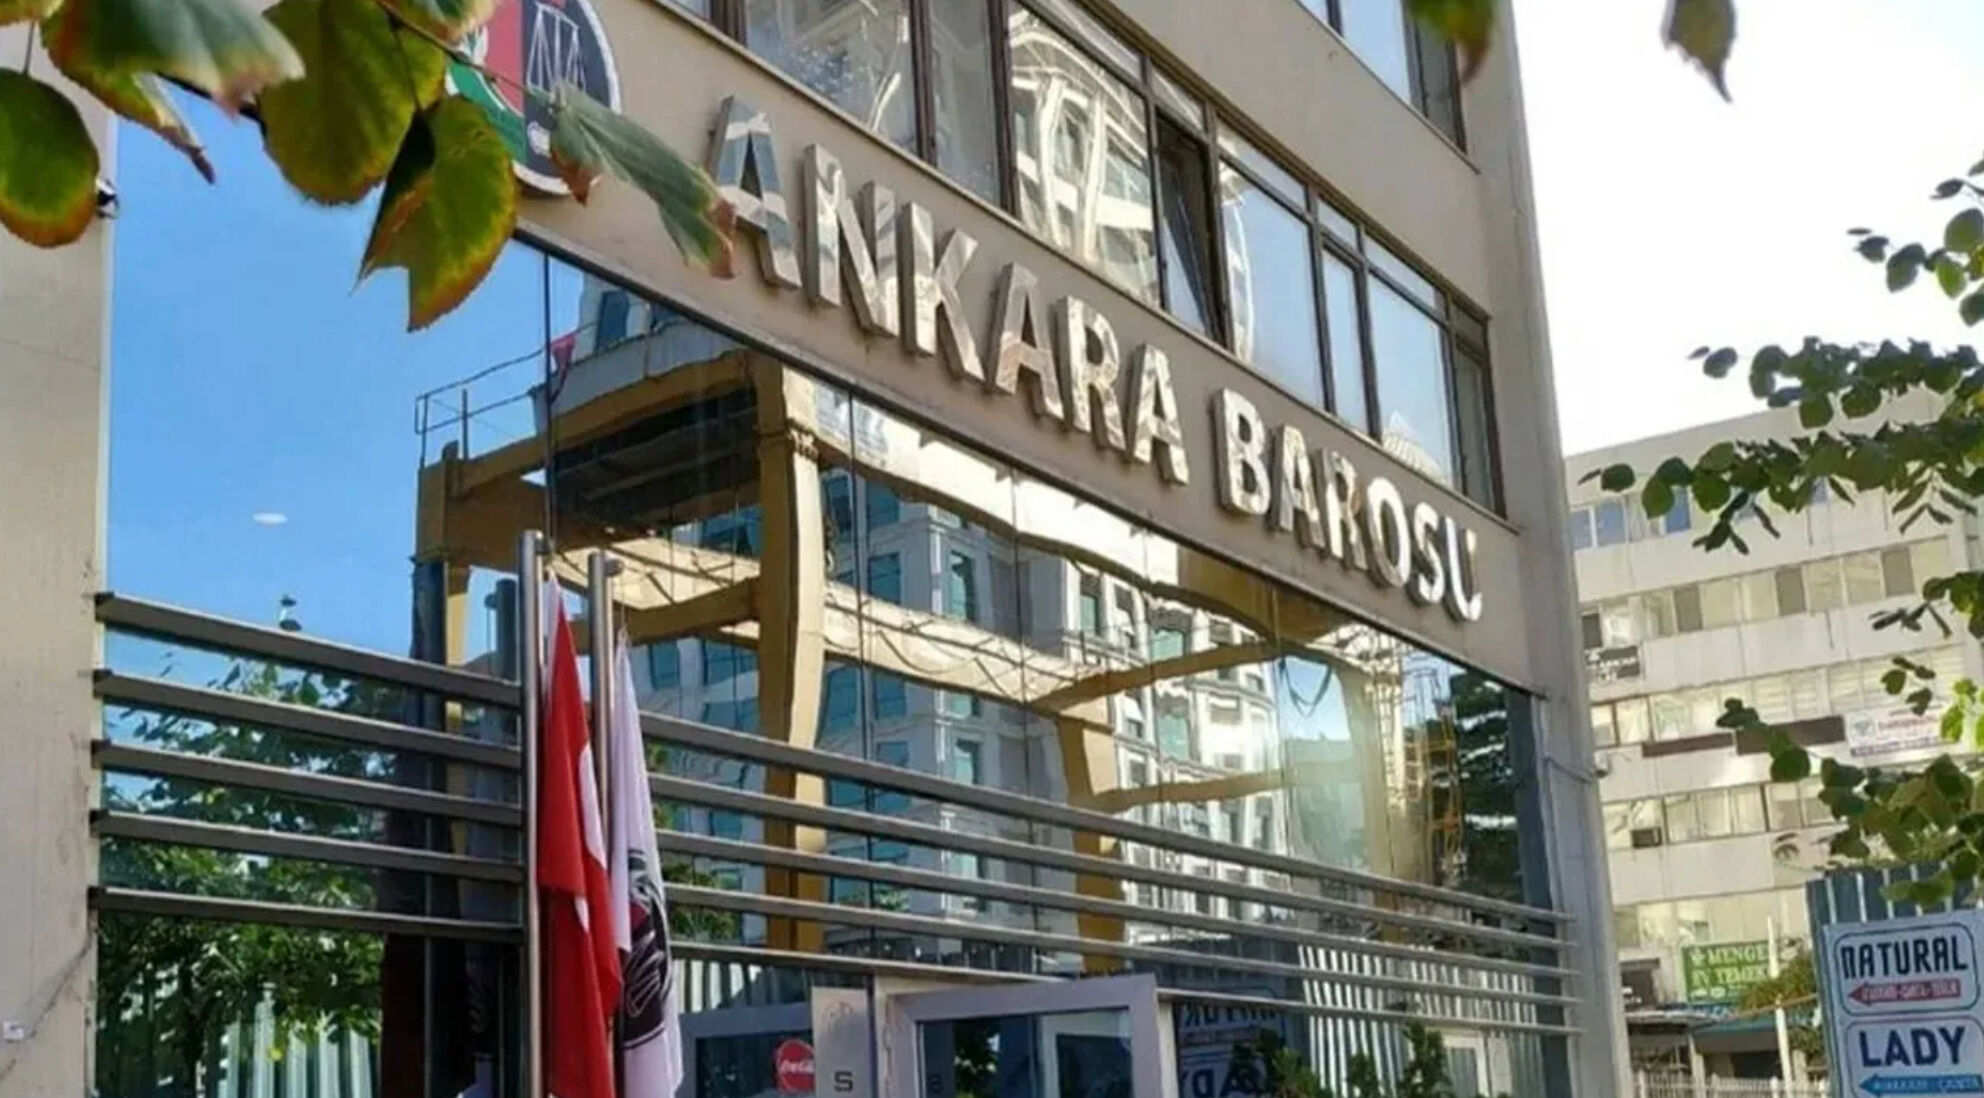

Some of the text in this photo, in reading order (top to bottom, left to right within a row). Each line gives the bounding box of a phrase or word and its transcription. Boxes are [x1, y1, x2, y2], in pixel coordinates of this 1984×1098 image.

[711, 95, 1483, 621] ANKARA BAROSU
[1708, 944, 1769, 967] MENGE
[1840, 935, 1969, 979] NATURAL
[1858, 1026, 1966, 1068] LADY
